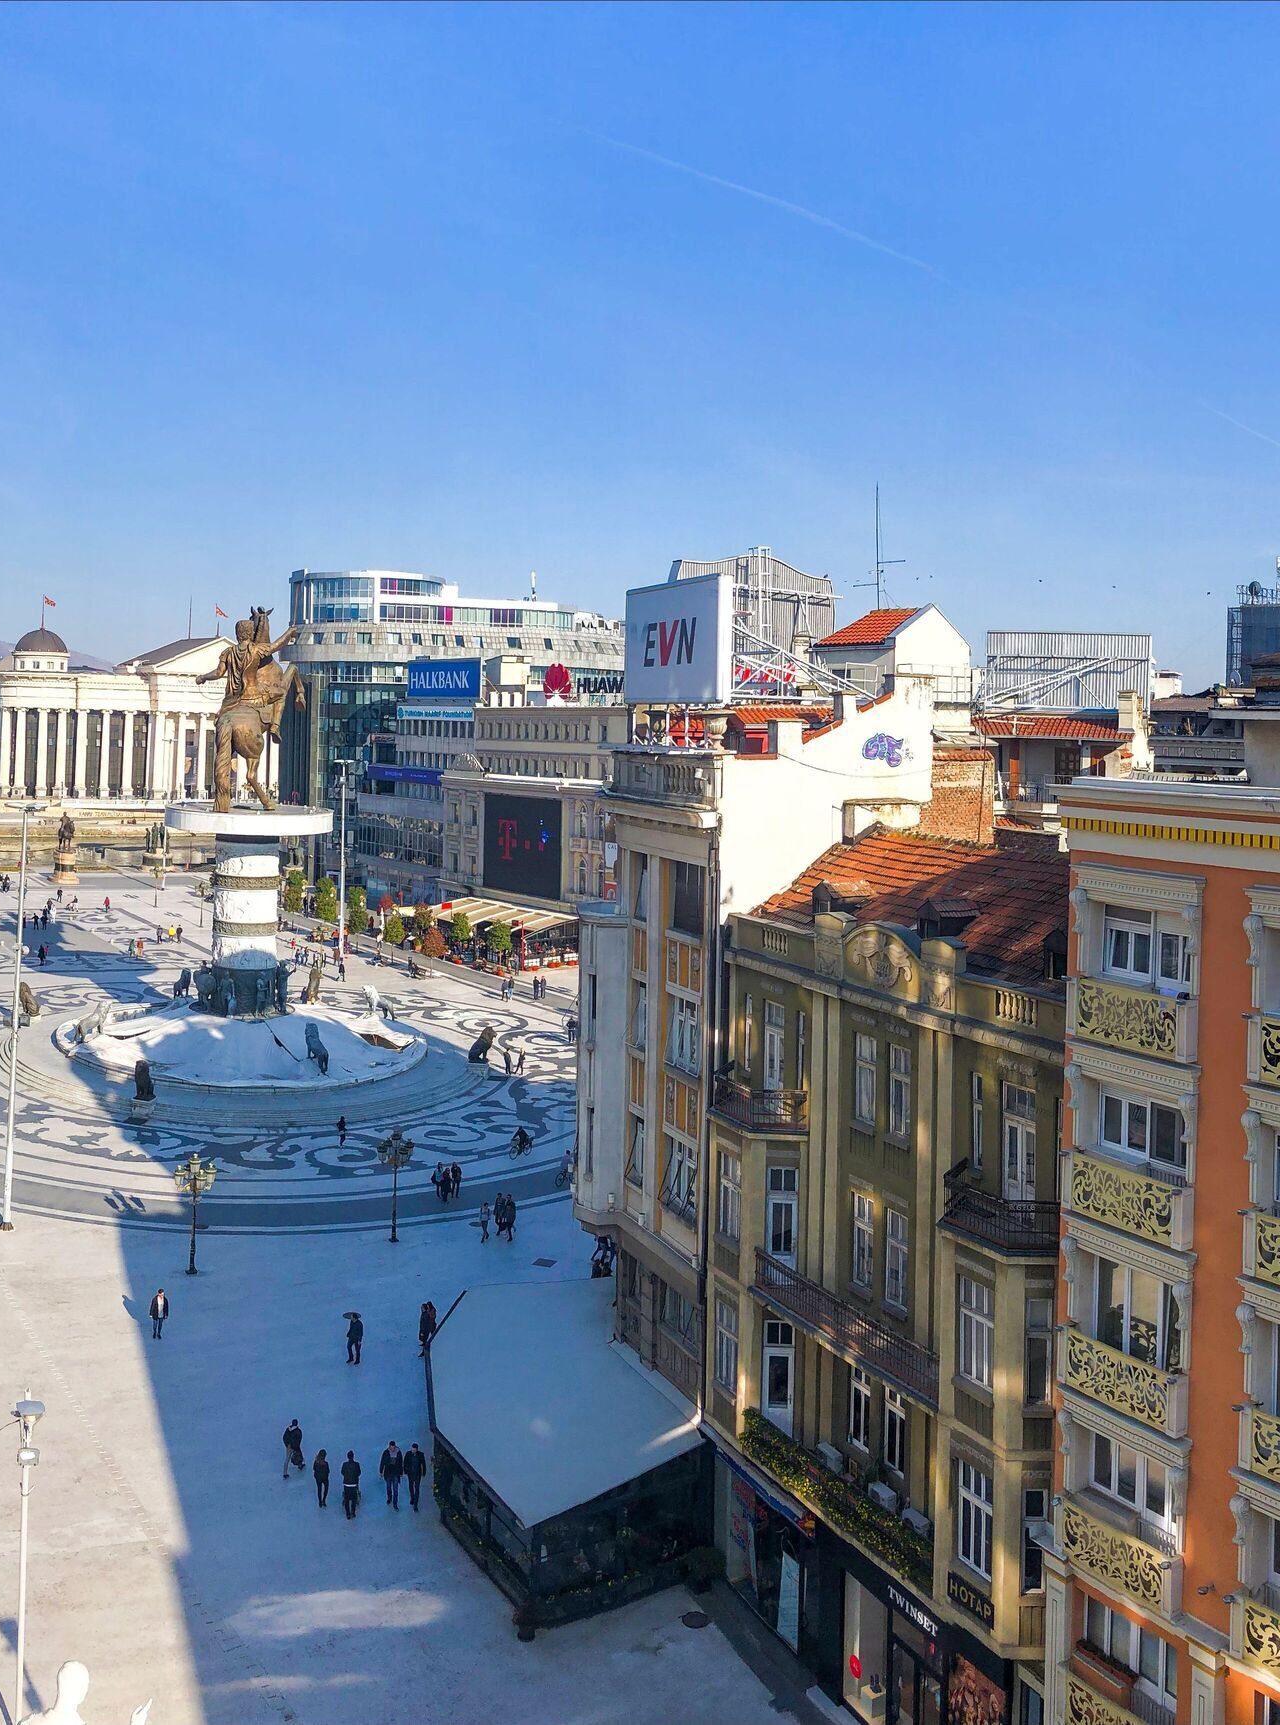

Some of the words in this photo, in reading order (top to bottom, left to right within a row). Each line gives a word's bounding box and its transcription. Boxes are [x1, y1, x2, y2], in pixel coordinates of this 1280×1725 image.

[643, 617, 697, 668] EVN
[410, 670, 470, 689] HALKBANK
[887, 1585, 938, 1637] TWINSET
